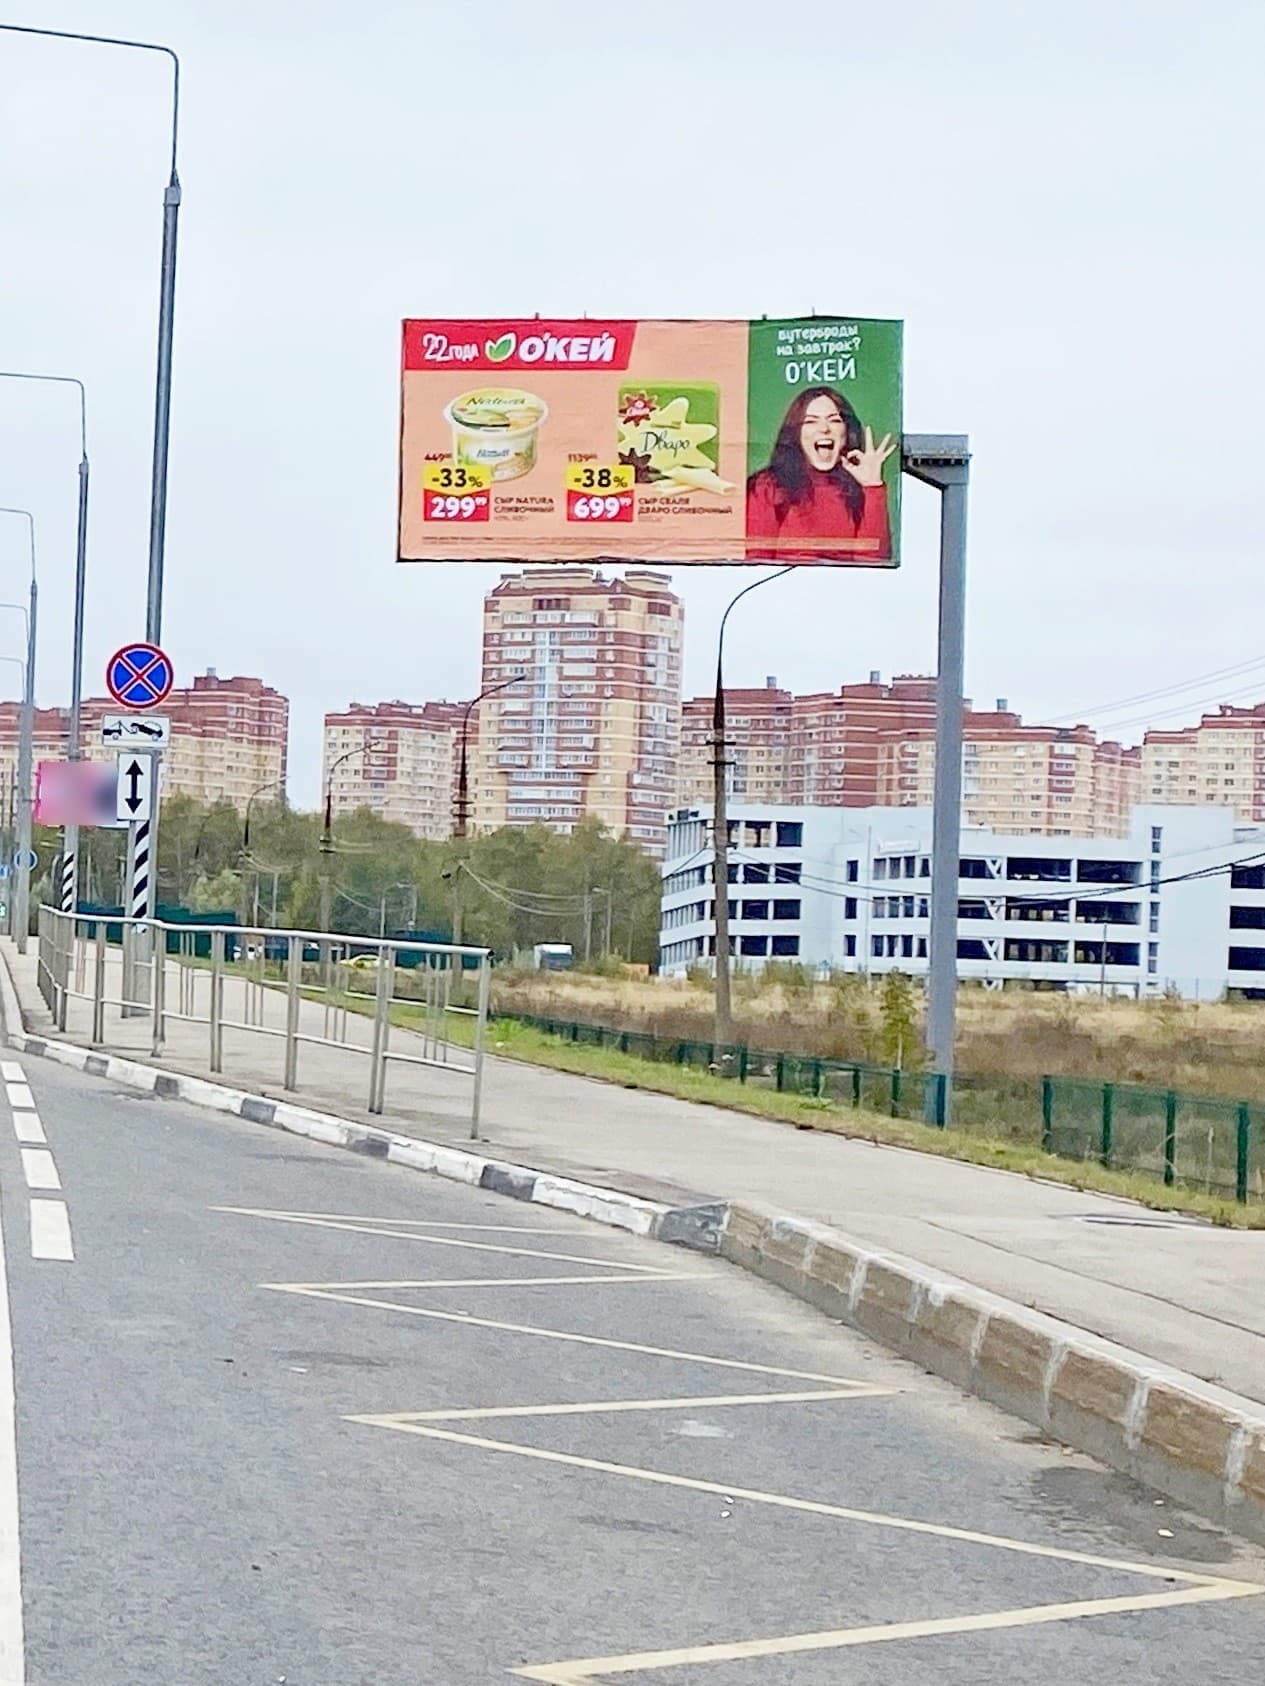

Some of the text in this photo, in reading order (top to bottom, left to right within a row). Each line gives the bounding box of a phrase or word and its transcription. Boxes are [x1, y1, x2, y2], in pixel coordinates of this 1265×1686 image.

[423, 333, 450, 361] 22
[519, 332, 617, 362] О'КЕЙ
[785, 353, 857, 384] О'КЕЙ
